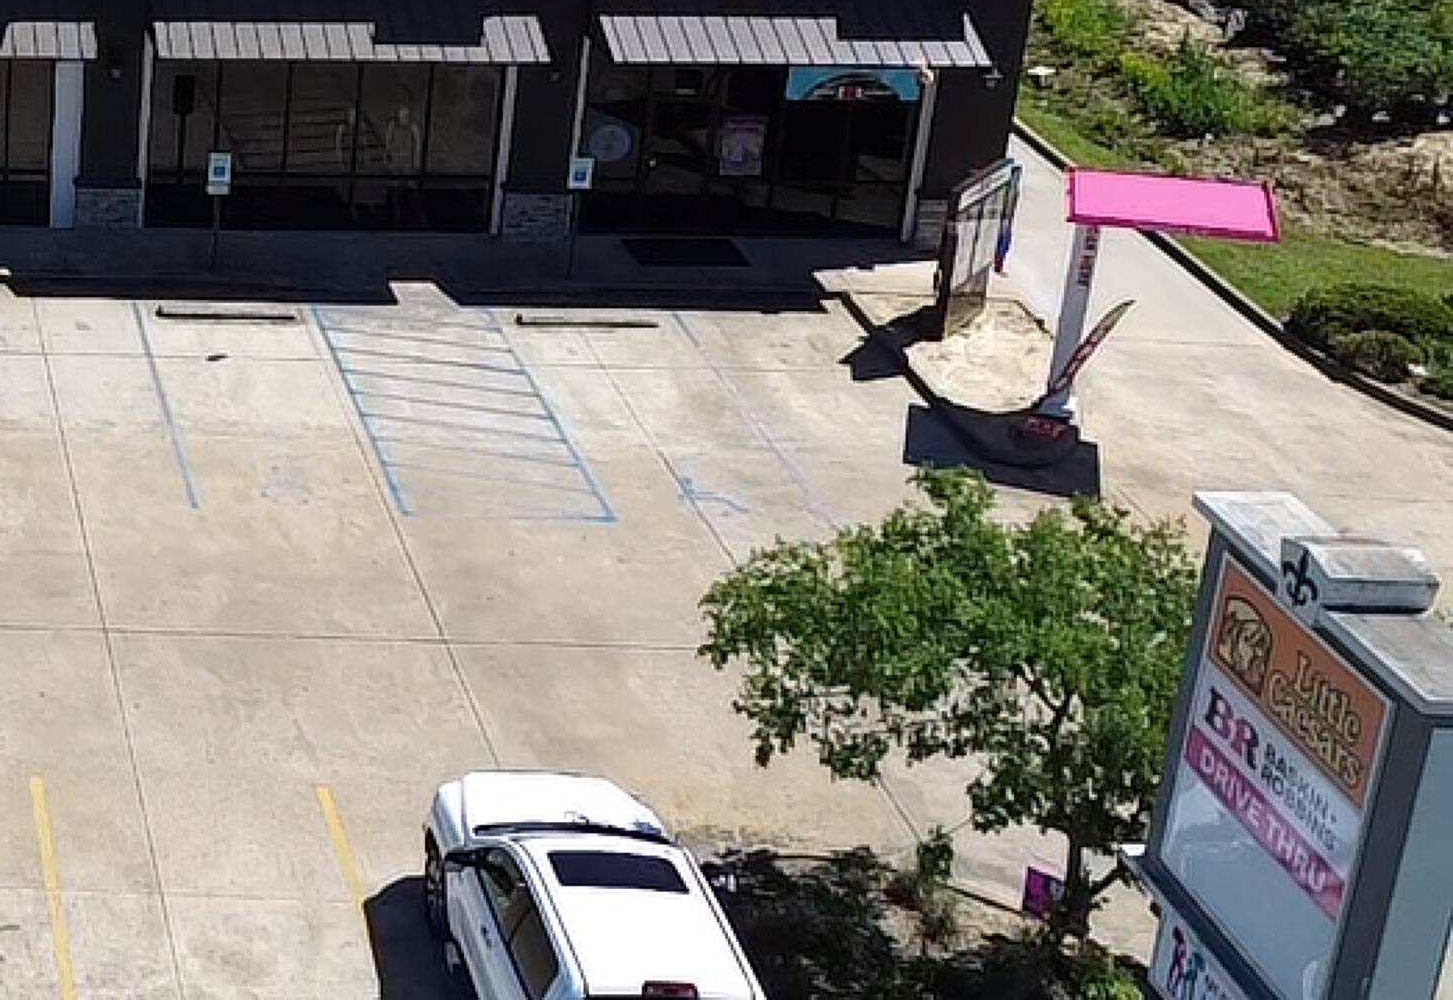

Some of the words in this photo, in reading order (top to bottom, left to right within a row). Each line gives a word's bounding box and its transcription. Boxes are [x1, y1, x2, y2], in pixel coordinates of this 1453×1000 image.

[1268, 669, 1362, 790] Caesars
[1295, 649, 1362, 742] Little
[1199, 746, 1263, 829] DRIVE
[1264, 814, 1327, 892] THRU
